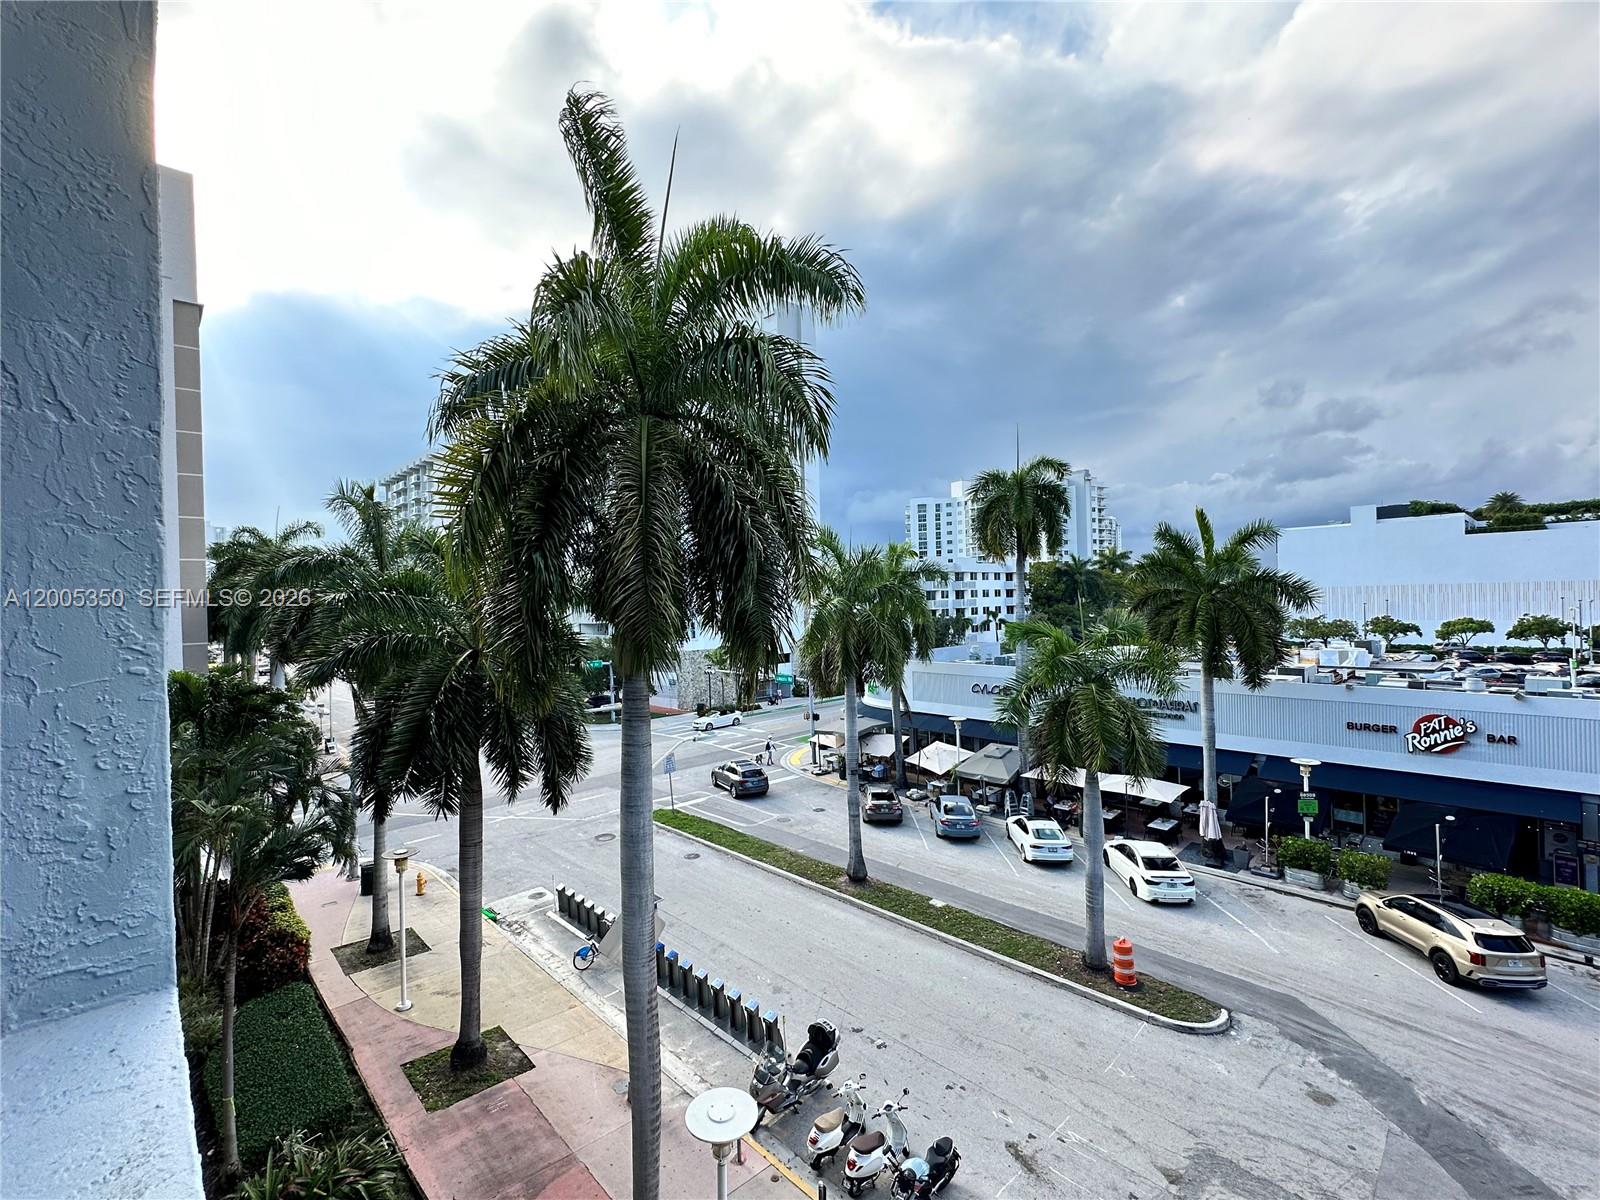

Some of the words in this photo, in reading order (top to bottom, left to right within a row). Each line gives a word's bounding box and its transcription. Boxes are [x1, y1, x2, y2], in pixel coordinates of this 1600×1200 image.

[1346, 721, 1398, 734] BURGER
[1420, 715, 1448, 737] FAT
[1405, 717, 1478, 753] Ronnie's
[1486, 733, 1518, 745] BAR
